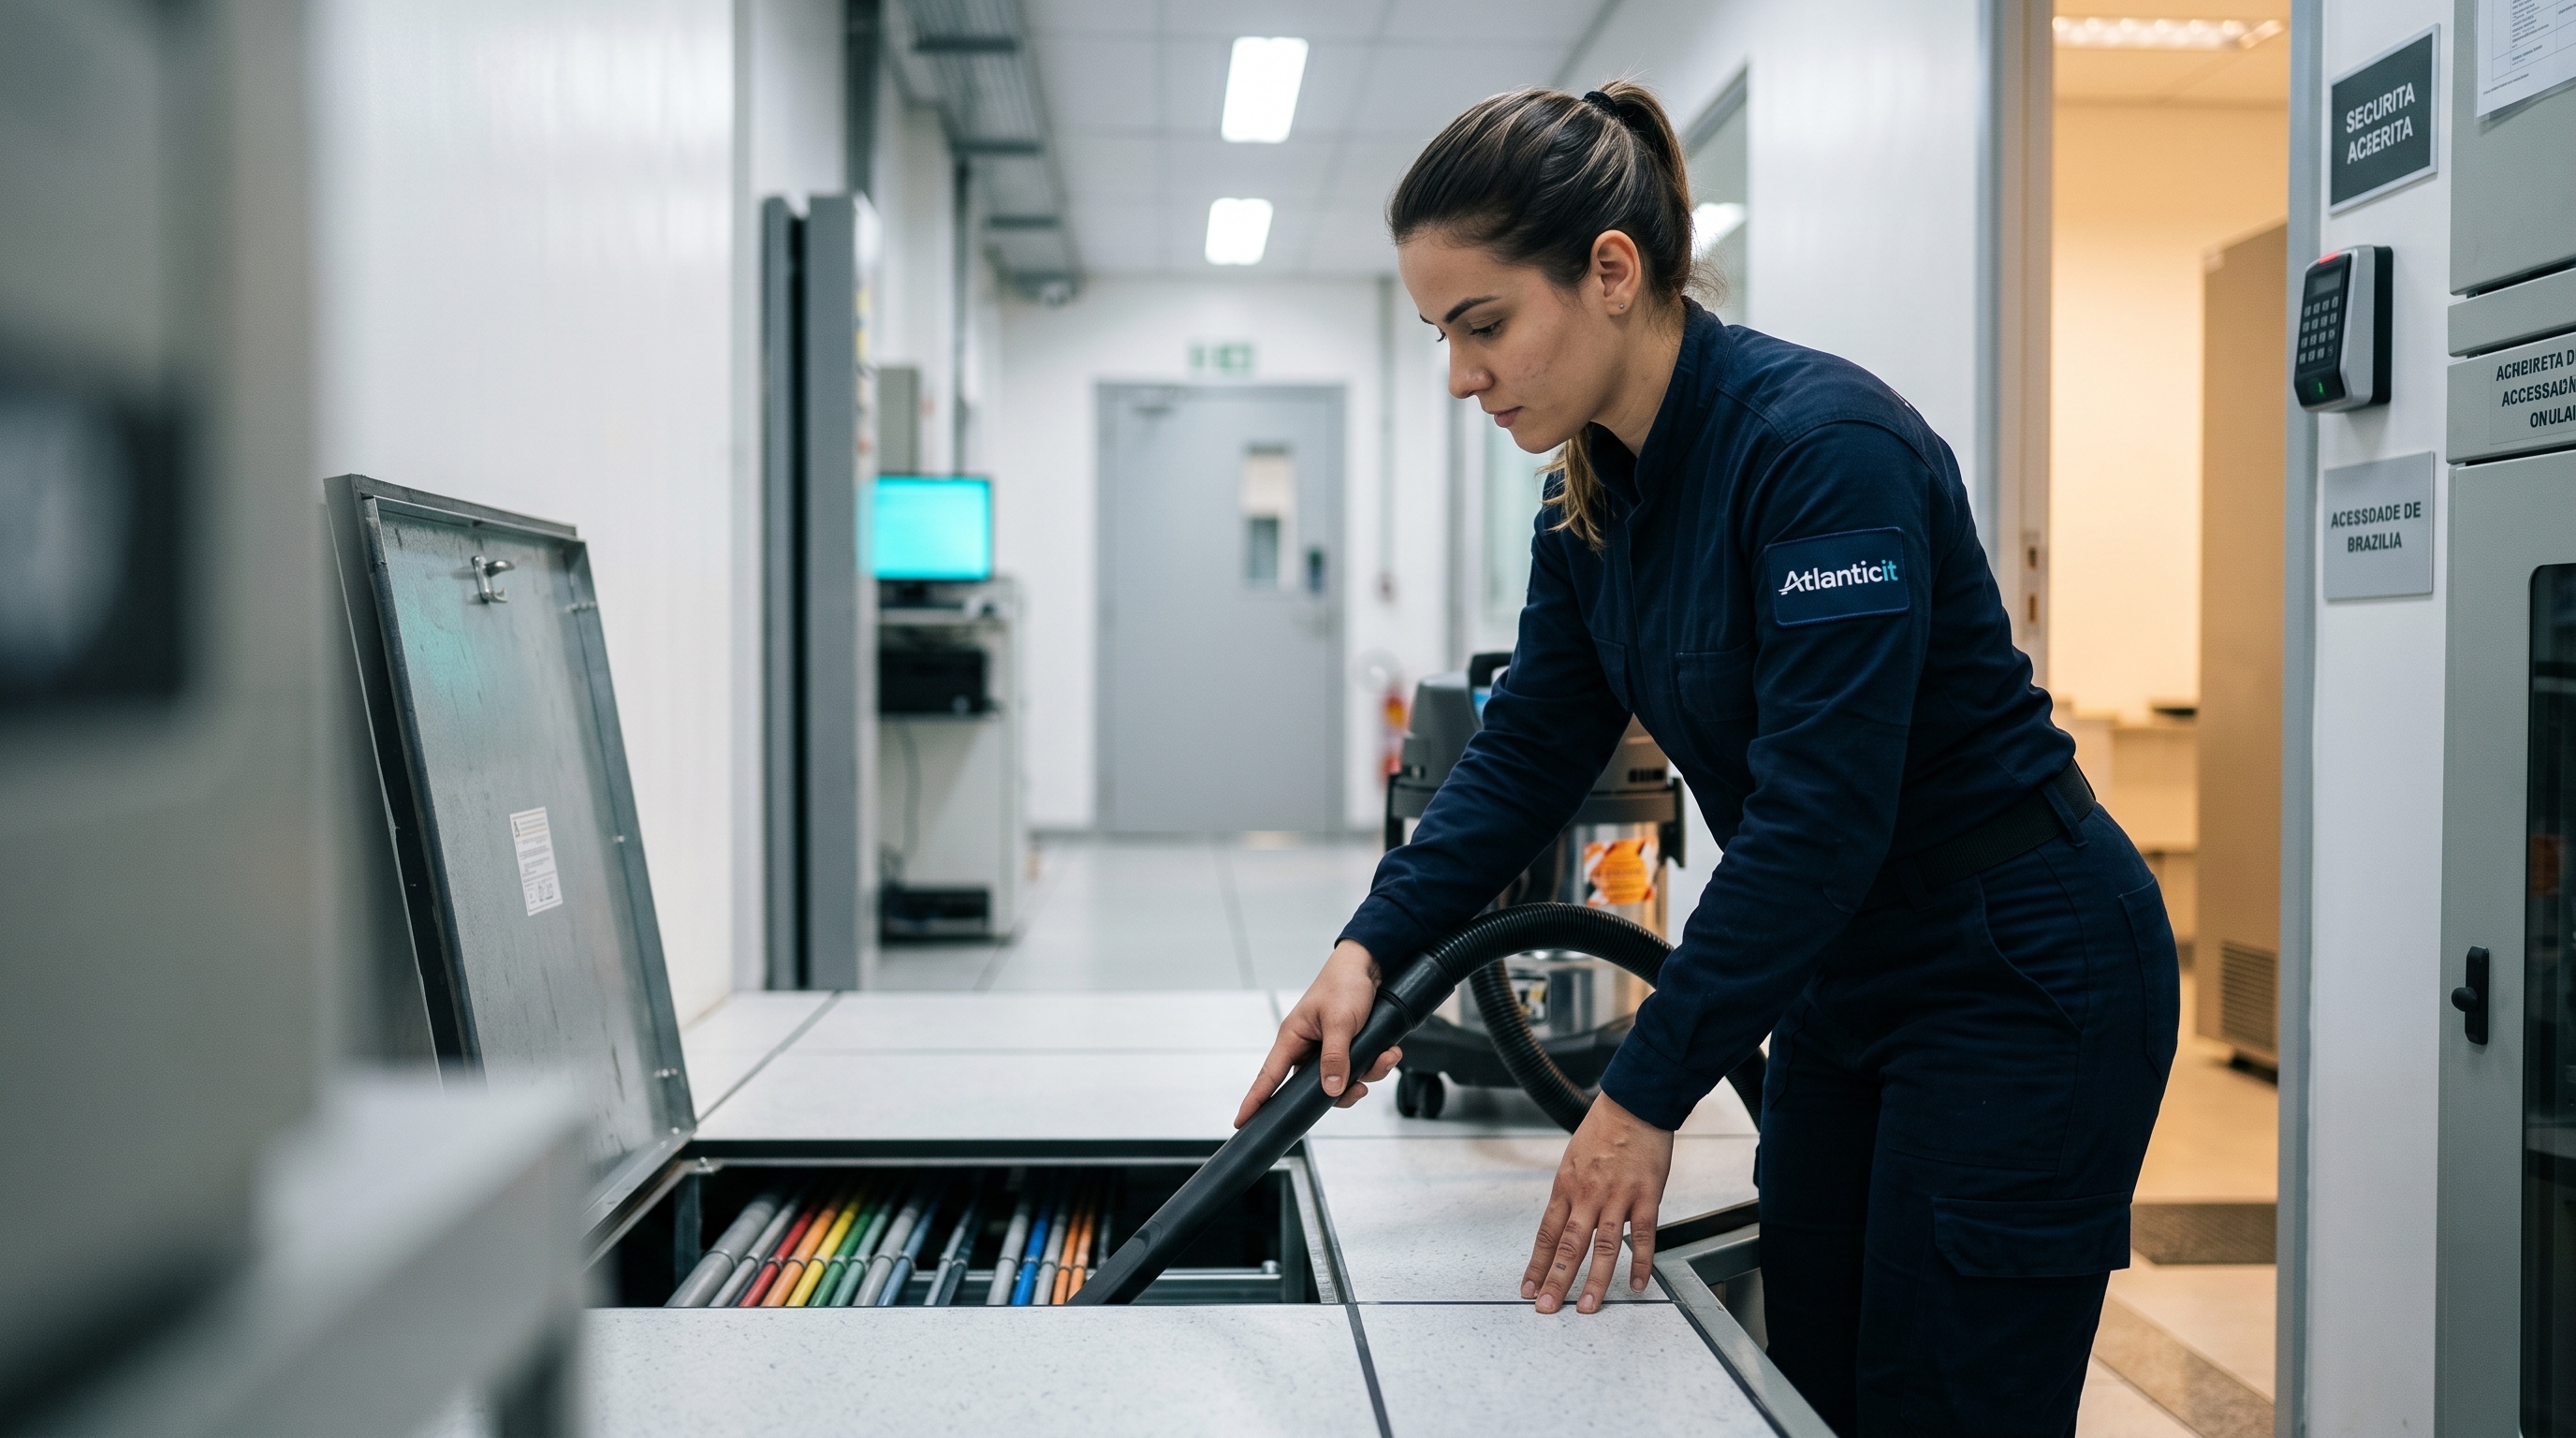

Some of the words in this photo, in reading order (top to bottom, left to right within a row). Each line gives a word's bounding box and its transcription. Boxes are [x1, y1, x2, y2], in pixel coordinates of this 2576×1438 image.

[2346, 82, 2416, 134] SECURITA
[2567, 349, 2576, 366] D
[2331, 504, 2401, 529] ACESSDADE
[2404, 501, 2422, 520] DE
[2347, 531, 2403, 552] BRAZILIA
